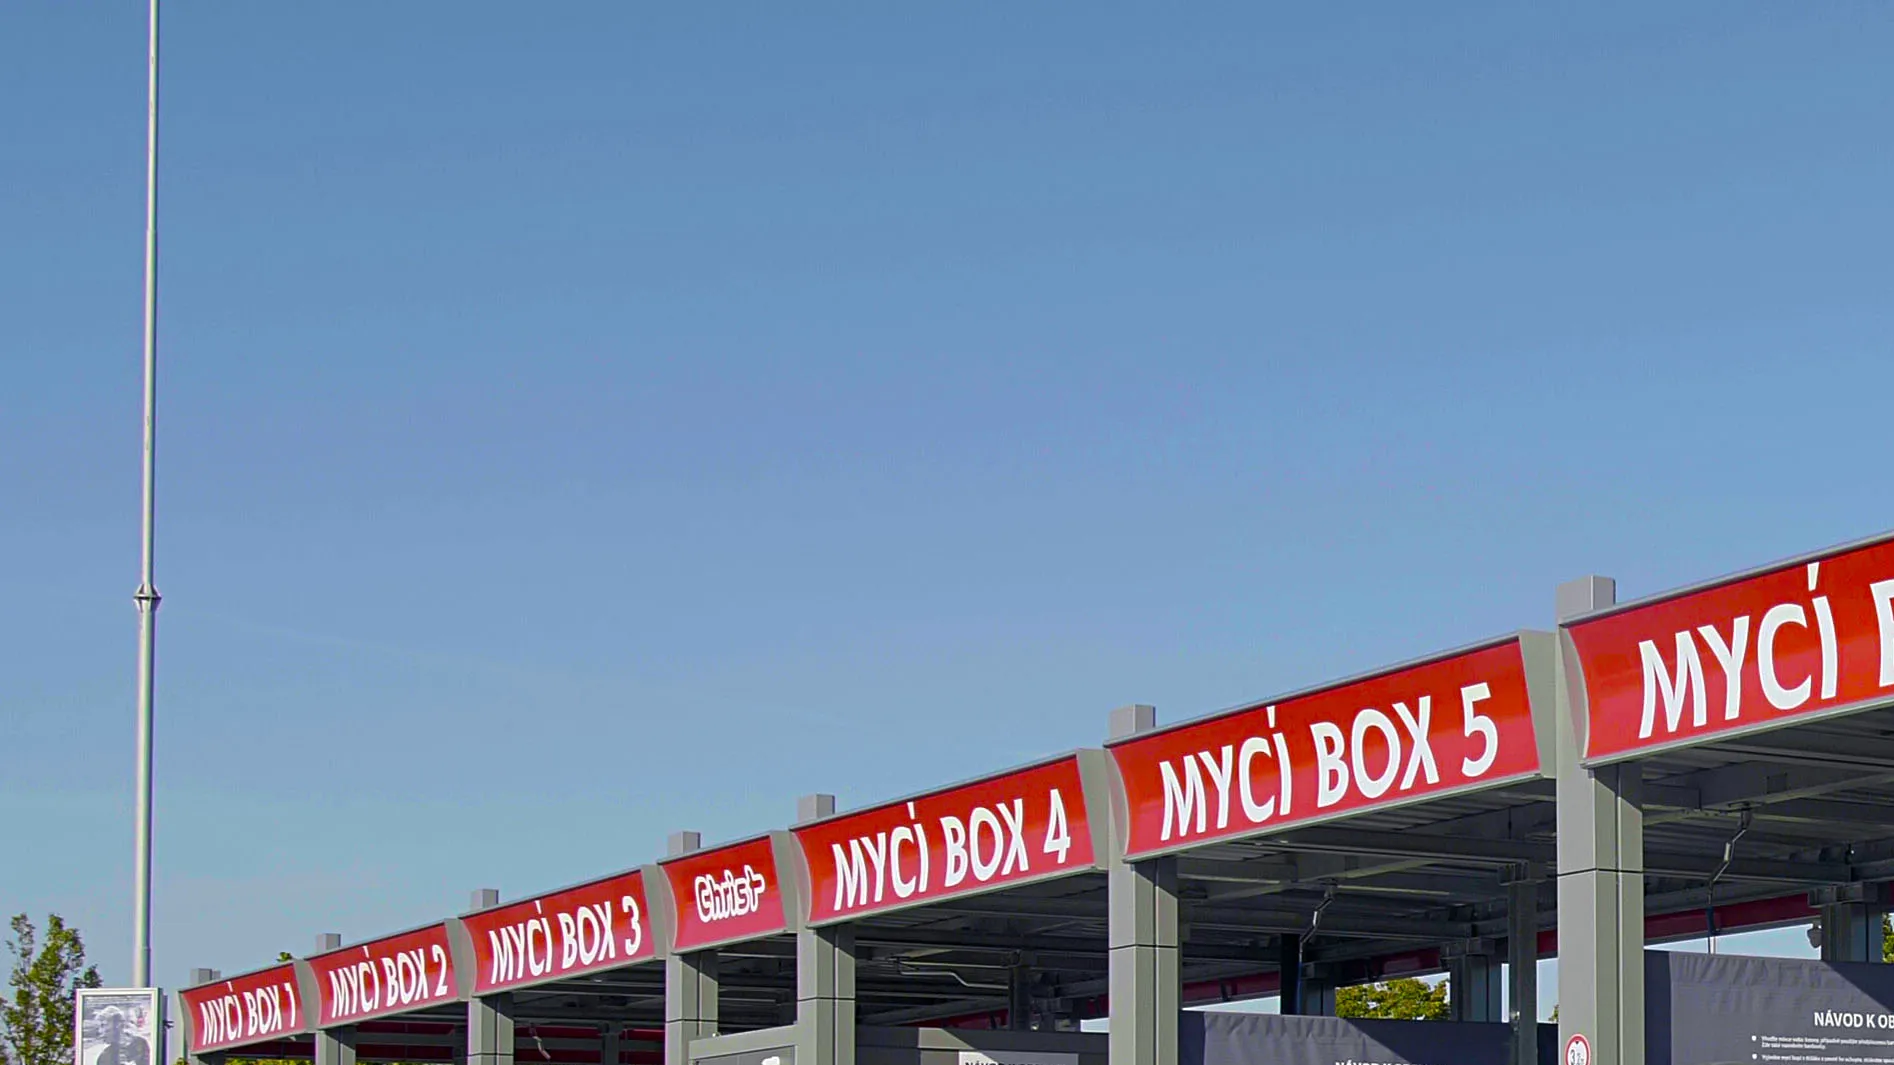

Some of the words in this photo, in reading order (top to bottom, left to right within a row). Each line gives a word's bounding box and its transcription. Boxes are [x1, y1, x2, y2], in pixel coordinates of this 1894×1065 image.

[1638, 562, 1838, 739] MYCÍ
[1159, 706, 1292, 841] MYCÍ
[1310, 695, 1440, 808] BOX
[1460, 682, 1498, 777] 5
[832, 801, 929, 911] MYCÍ
[940, 798, 1029, 887] BOX
[1043, 788, 1071, 864] 4
[694, 865, 766, 923] Christ
[488, 900, 552, 985] MYCÍ
[559, 900, 615, 969] BOX
[622, 895, 641, 956] 3
[199, 981, 242, 1046] MYCÍ
[243, 985, 282, 1036] BOX
[284, 982, 297, 1028] 1
[328, 945, 380, 1019] MYCÍ
[381, 948, 428, 1008] BOX
[431, 944, 448, 997] 2
[1813, 1009, 1864, 1028] NÁVOD
[1866, 1013, 1876, 1028] K
